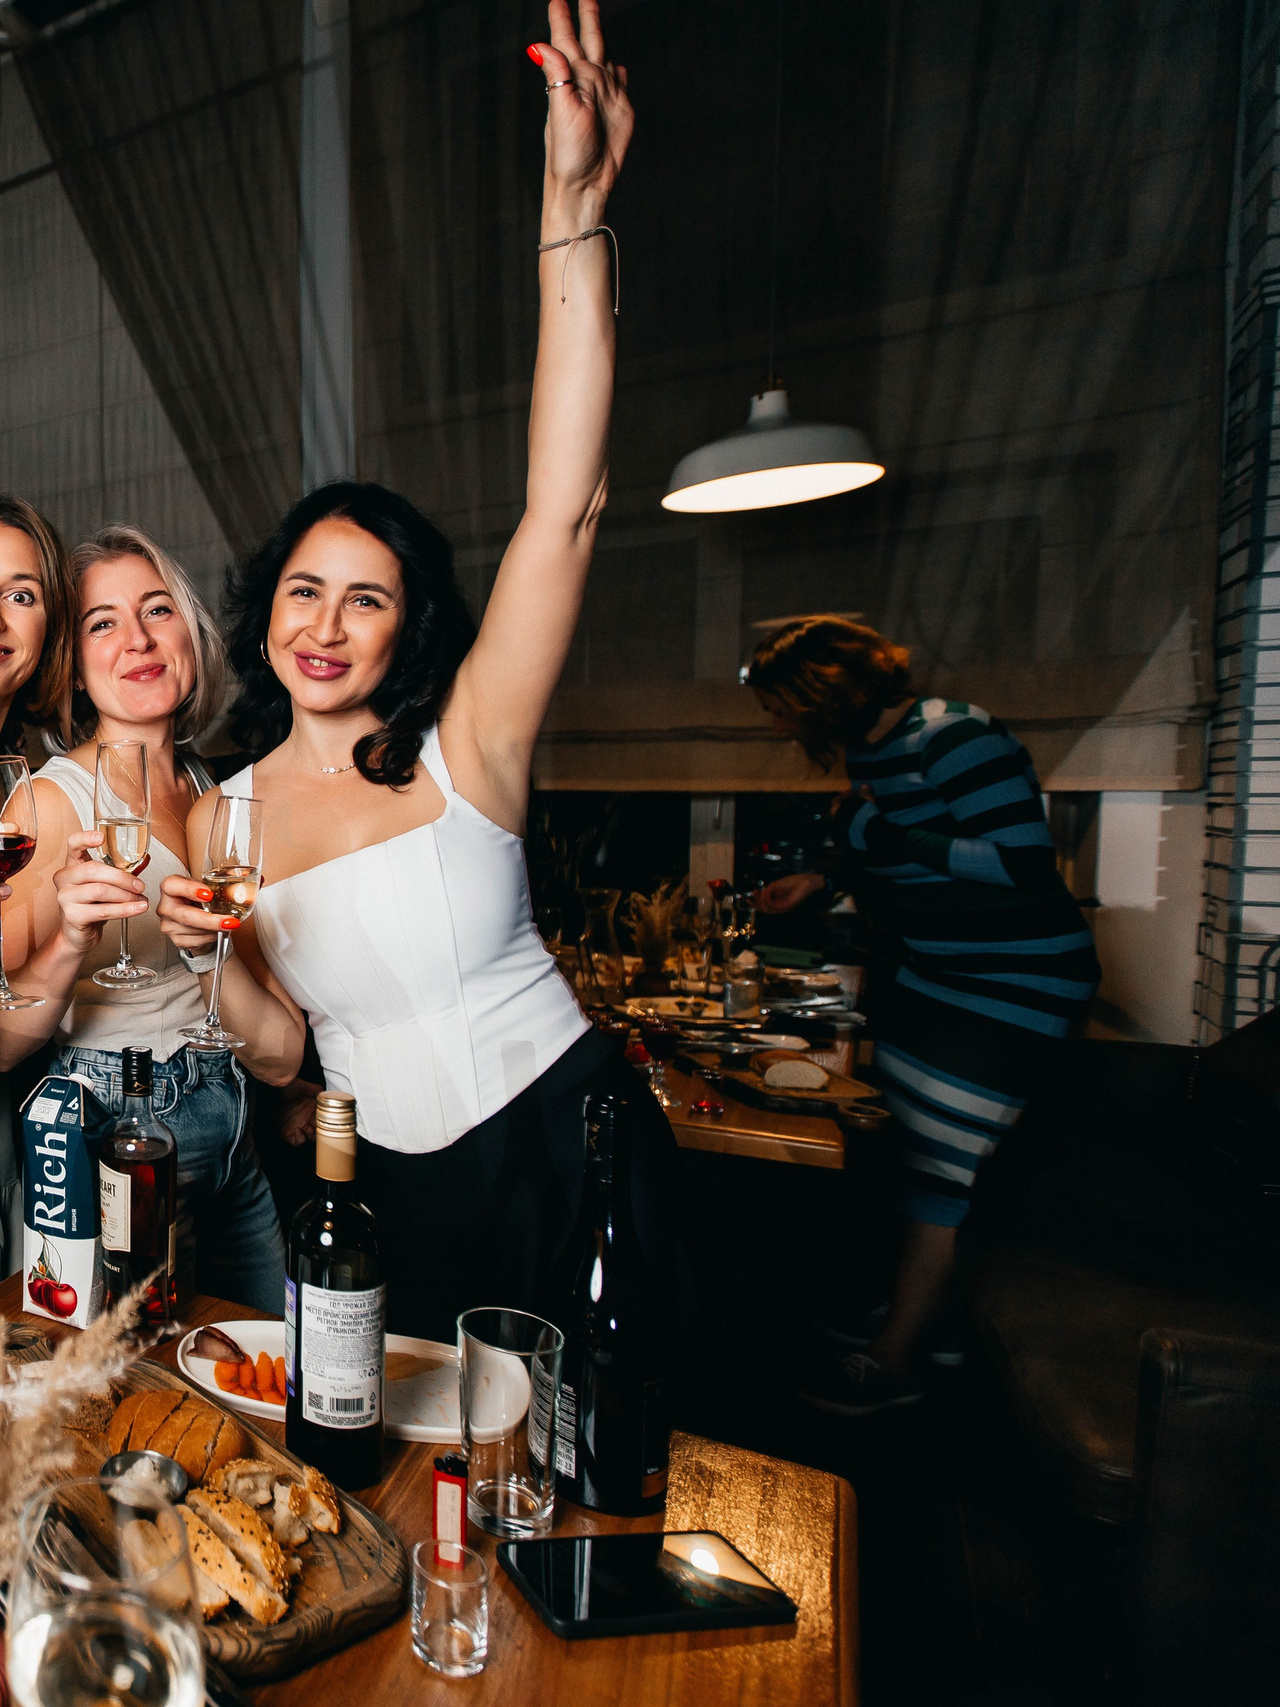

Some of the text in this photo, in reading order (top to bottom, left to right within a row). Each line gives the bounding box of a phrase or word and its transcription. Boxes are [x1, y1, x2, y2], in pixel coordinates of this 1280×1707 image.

[34, 1131, 67, 1233] Rich
[343, 1301, 367, 1311] УРОЖАЯ
[305, 1305, 323, 1317] МЕСТО
[322, 1310, 371, 1321] ПРОИСХОЖДЕНИЯ
[316, 1316, 339, 1327] РЕГИОН
